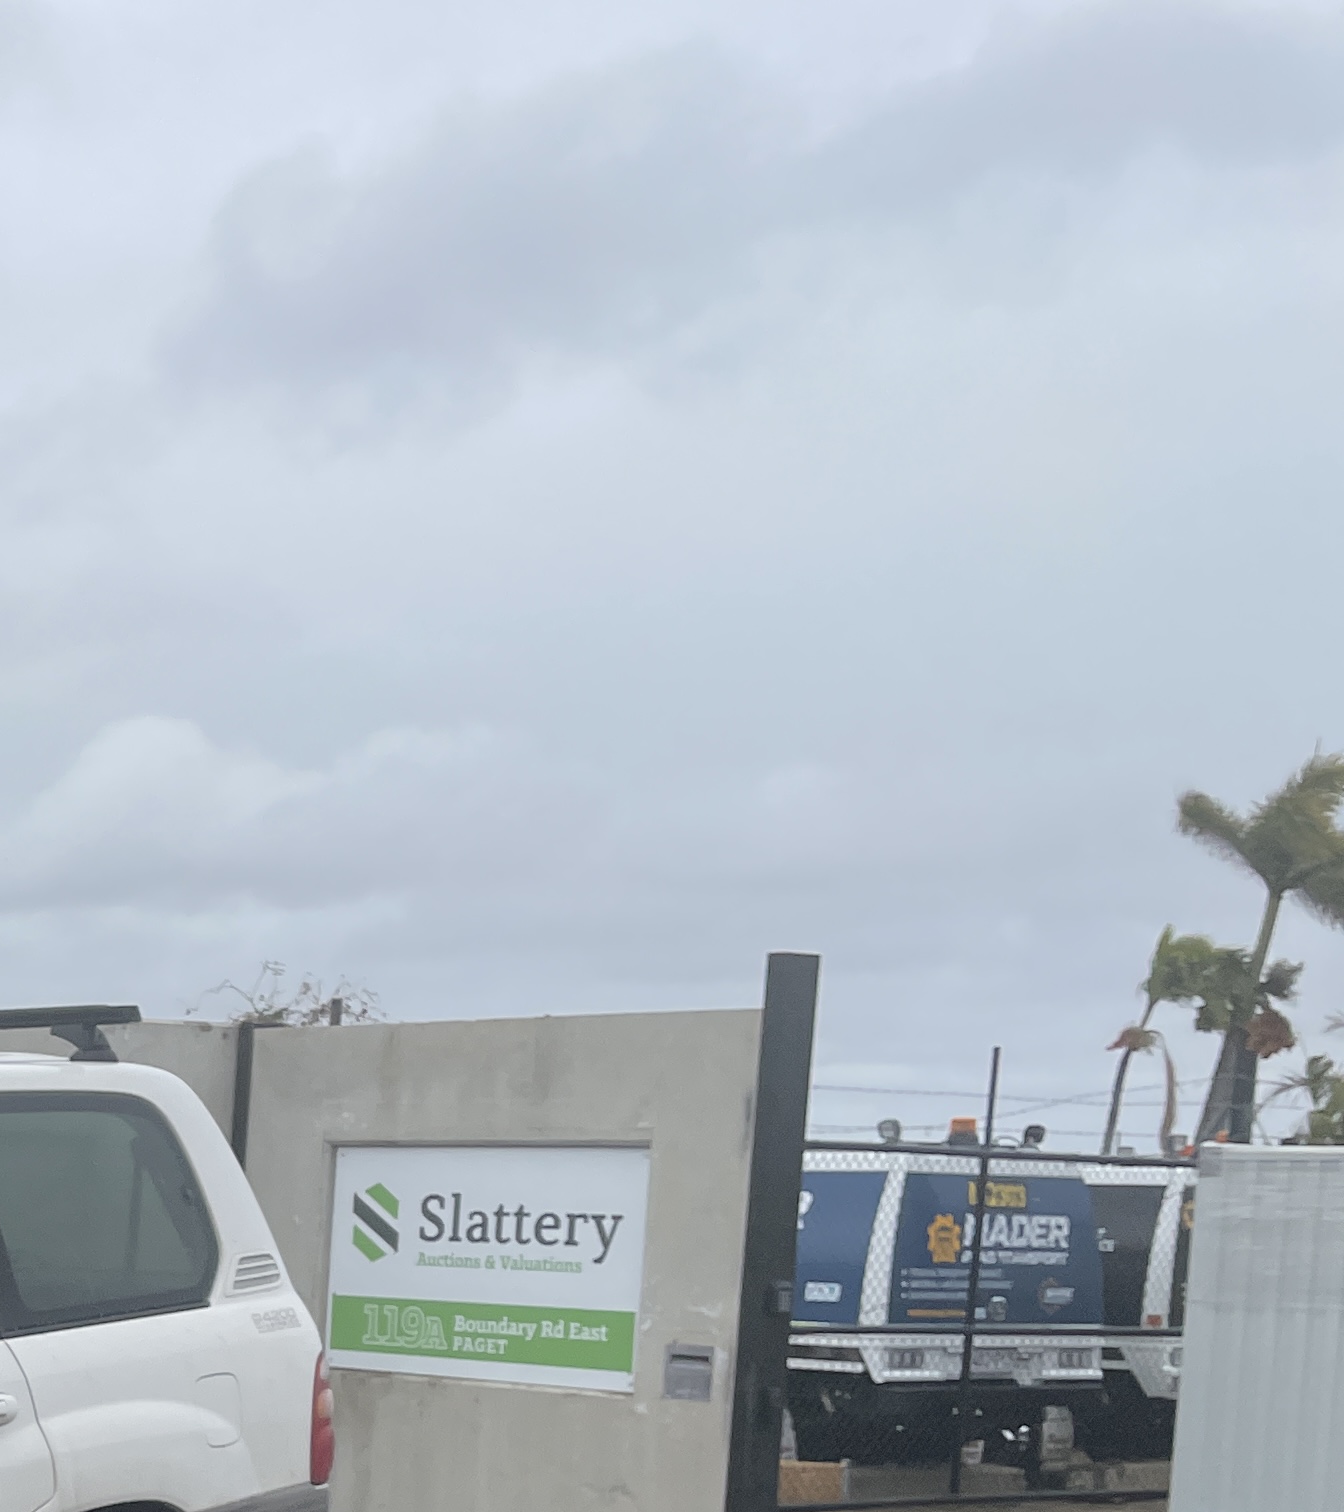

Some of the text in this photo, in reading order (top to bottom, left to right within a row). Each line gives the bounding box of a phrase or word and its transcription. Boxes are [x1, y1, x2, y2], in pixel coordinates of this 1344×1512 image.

[418, 1192, 625, 1264] Slattery
[416, 1251, 583, 1274] Auctions & Valuations
[453, 1314, 537, 1341] Boundary
[540, 1319, 565, 1339] Rd
[568, 1321, 609, 1342] East
[452, 1336, 509, 1355] PAGET
